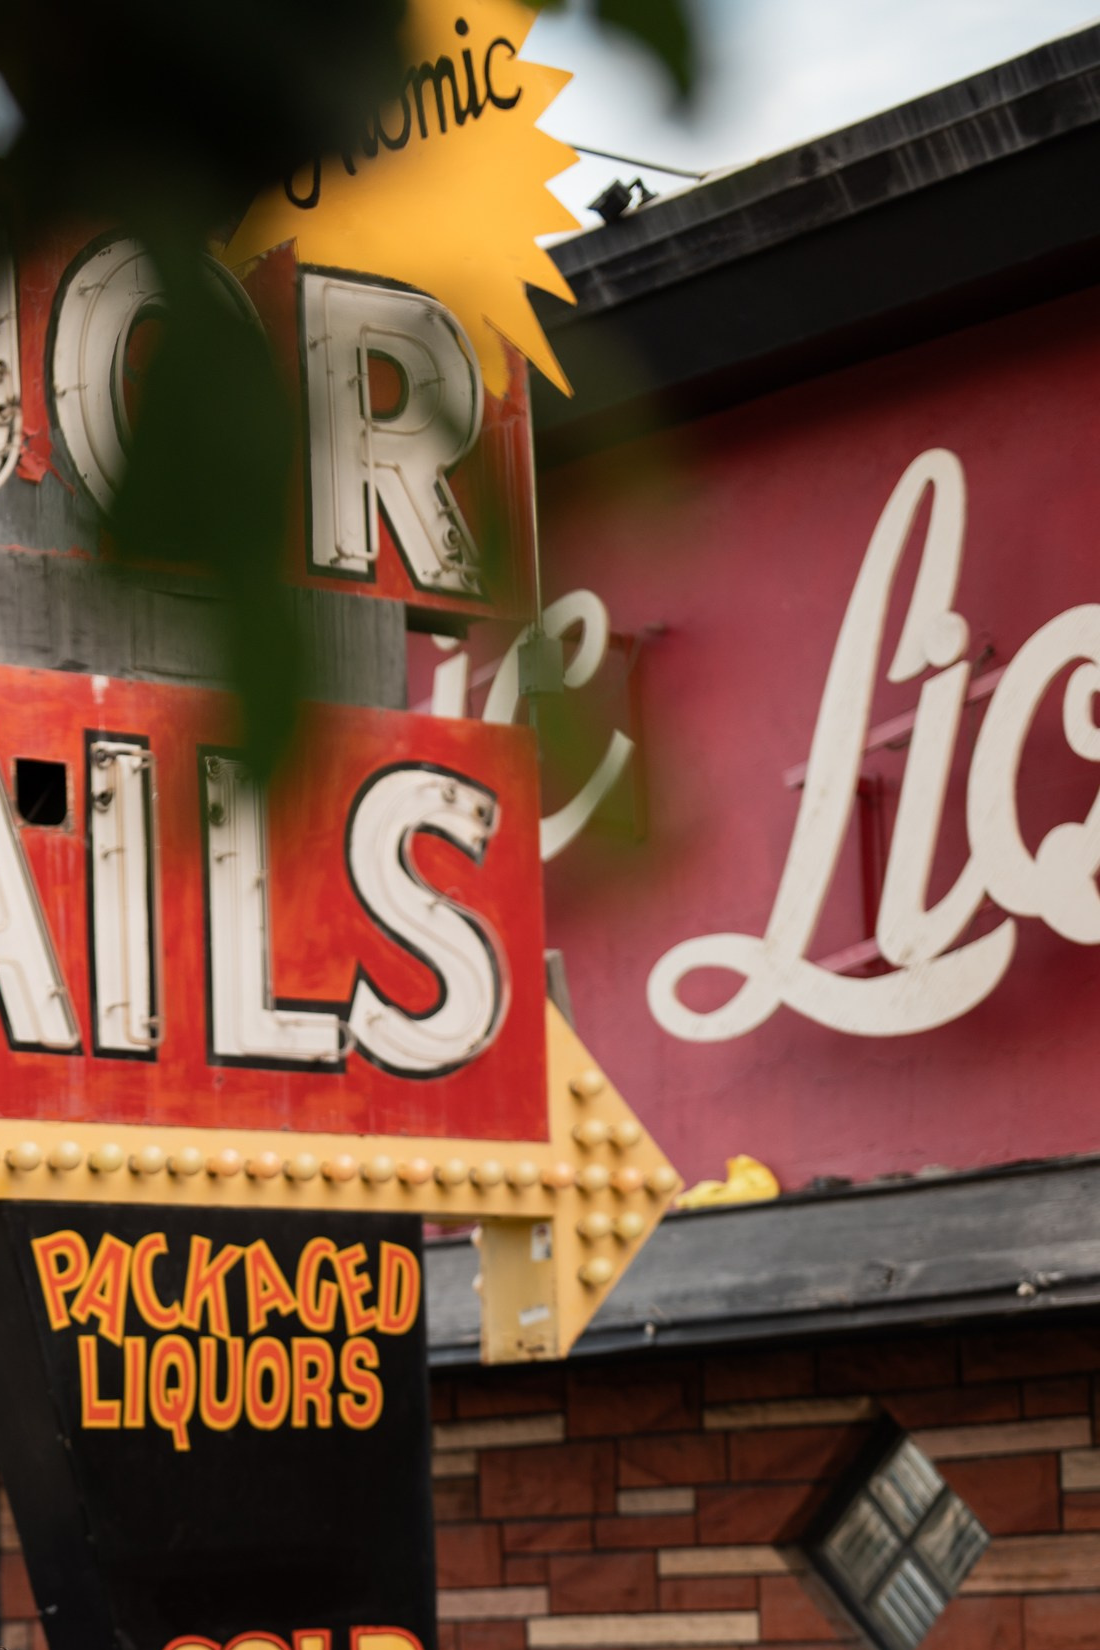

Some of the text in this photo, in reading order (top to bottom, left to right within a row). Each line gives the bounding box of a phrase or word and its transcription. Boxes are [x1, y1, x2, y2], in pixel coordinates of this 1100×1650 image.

[284, 17, 522, 210] omic
[31, 1229, 422, 1347] PACKAGED
[77, 1334, 386, 1452] LIQUORS
